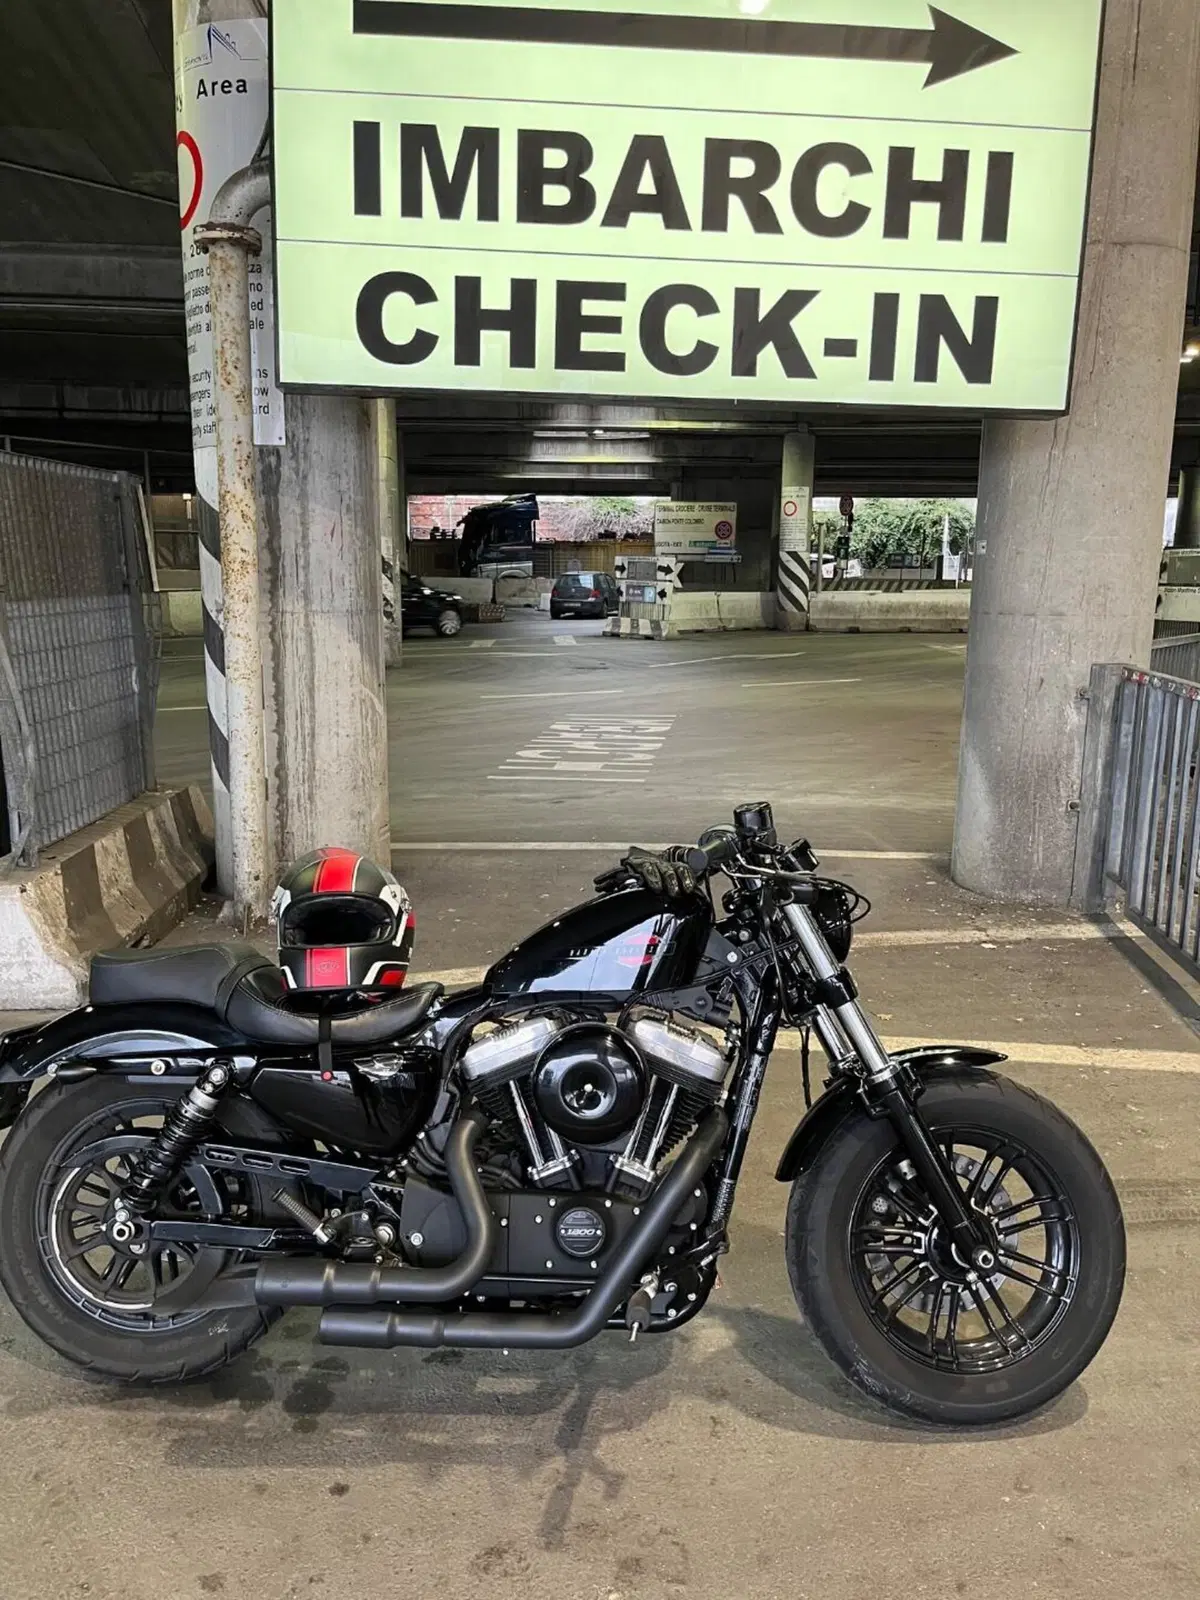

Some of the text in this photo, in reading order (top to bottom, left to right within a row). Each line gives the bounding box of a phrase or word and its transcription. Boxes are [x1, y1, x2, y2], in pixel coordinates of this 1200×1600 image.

[196, 78, 248, 99] Area
[353, 120, 1014, 243] IMBARCHI
[355, 271, 999, 384] CHECK-IN
[486, 712, 679, 784] IMBARCHI
